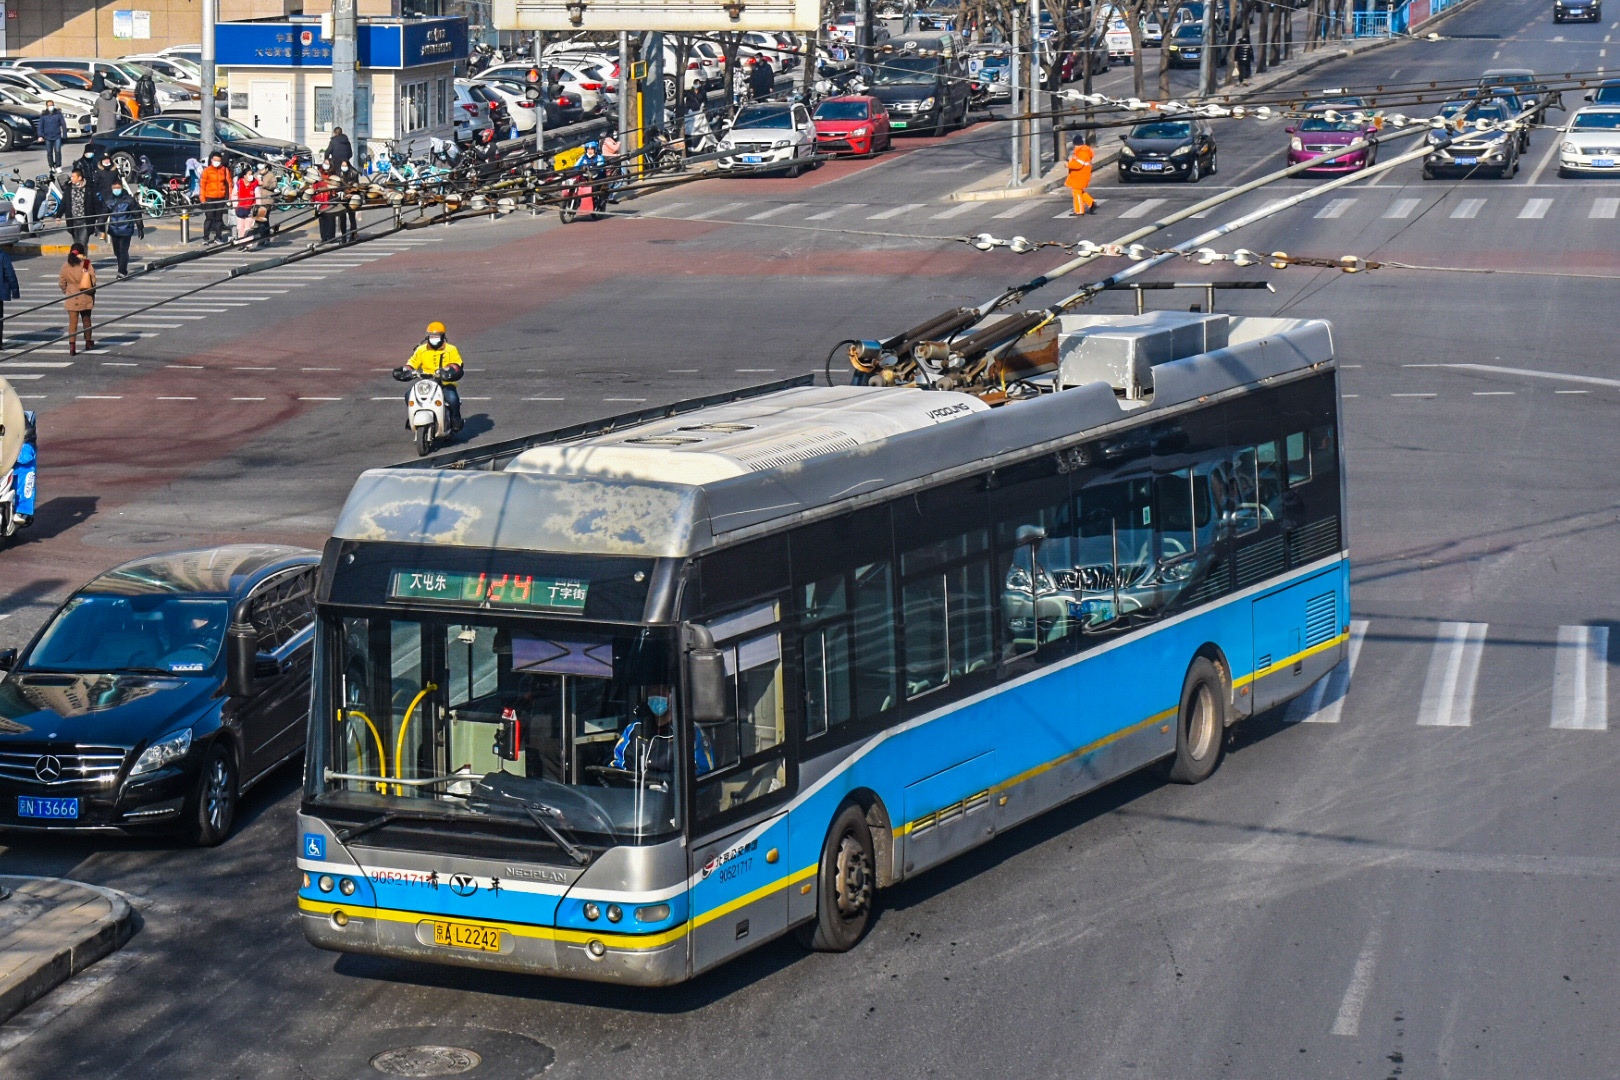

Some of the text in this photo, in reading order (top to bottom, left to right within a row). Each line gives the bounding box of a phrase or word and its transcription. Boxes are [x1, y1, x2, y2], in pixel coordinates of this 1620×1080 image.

[475, 572, 533, 601] 124
[547, 586, 587, 601] 丁字街
[504, 866, 568, 884] NEOPLAN
[719, 857, 753, 884] 90521717
